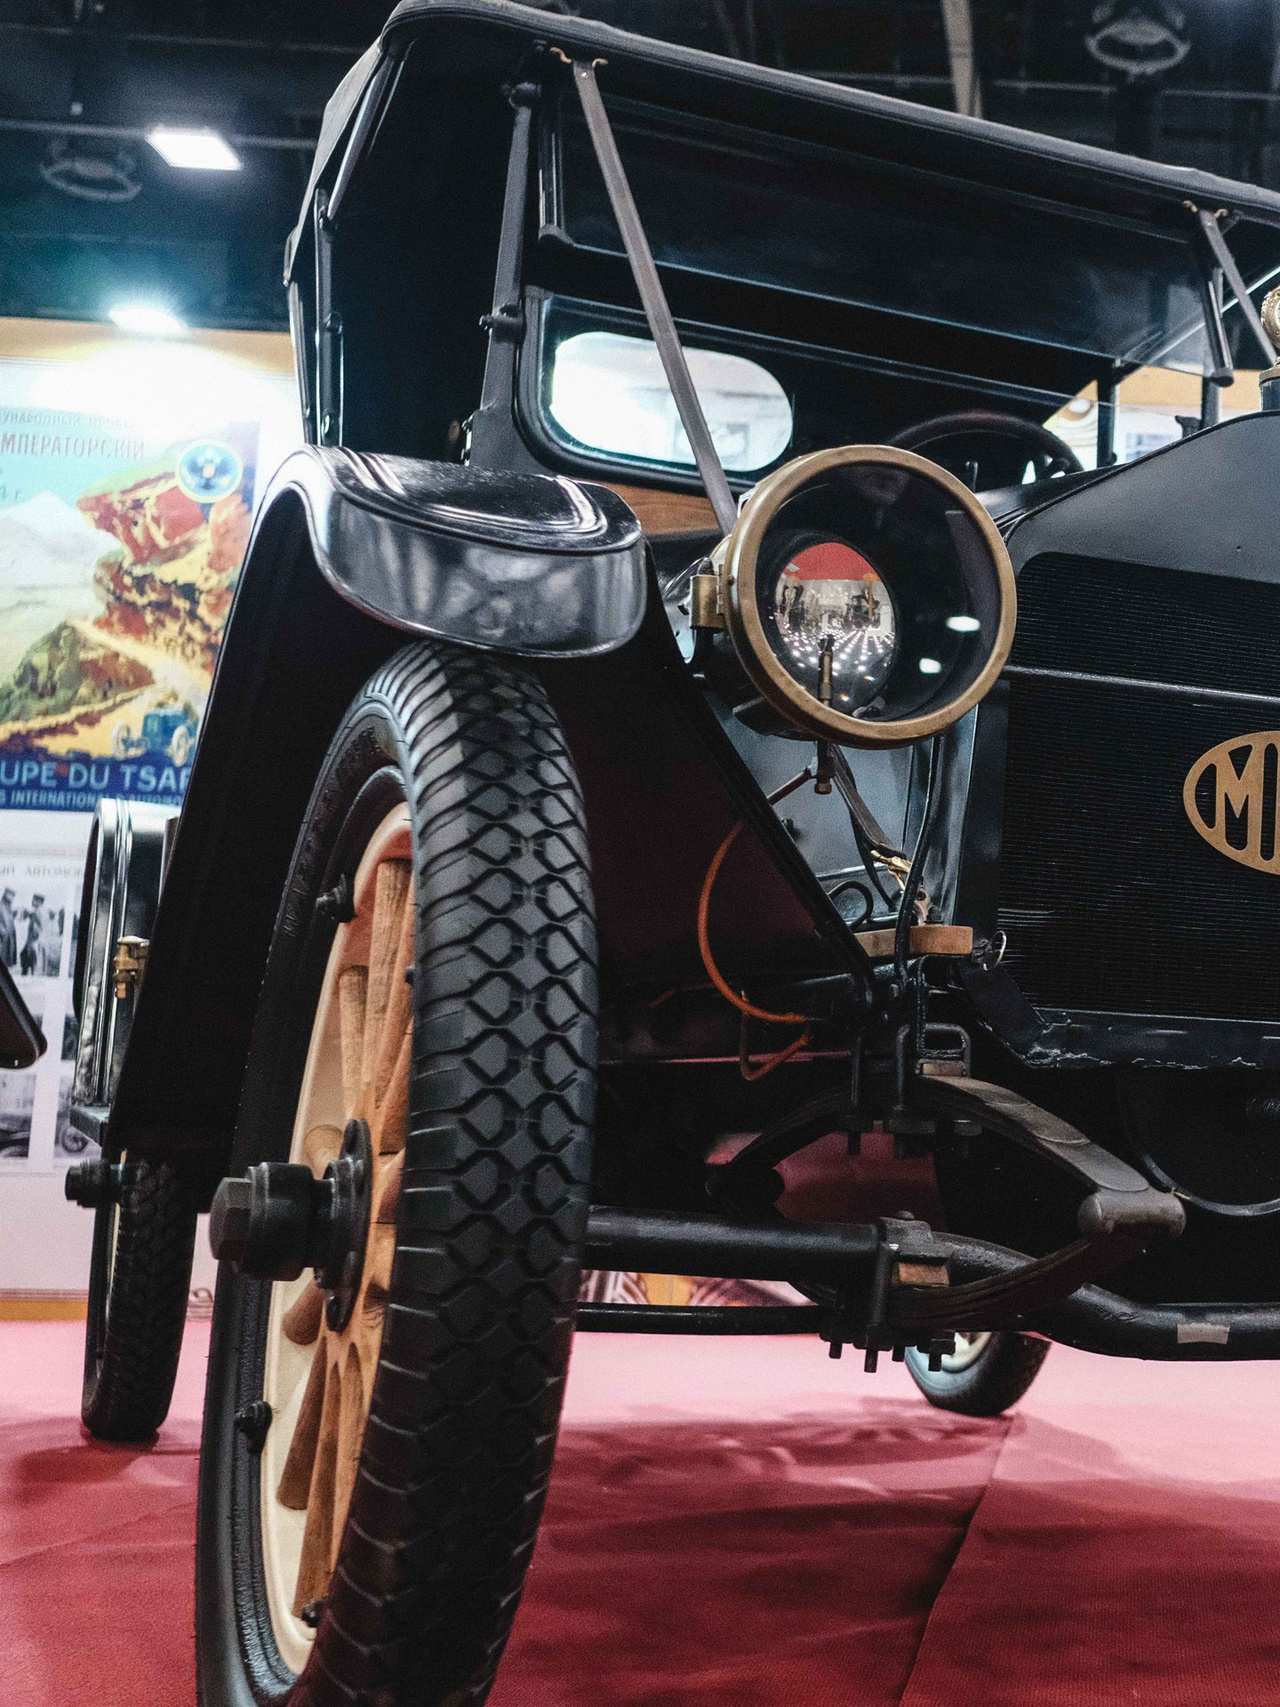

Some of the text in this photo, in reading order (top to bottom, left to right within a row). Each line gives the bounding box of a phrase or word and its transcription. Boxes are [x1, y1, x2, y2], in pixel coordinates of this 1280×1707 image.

[0, 760, 57, 788] UPE
[68, 762, 110, 790] DU
[11, 788, 109, 809] INTERNATION
